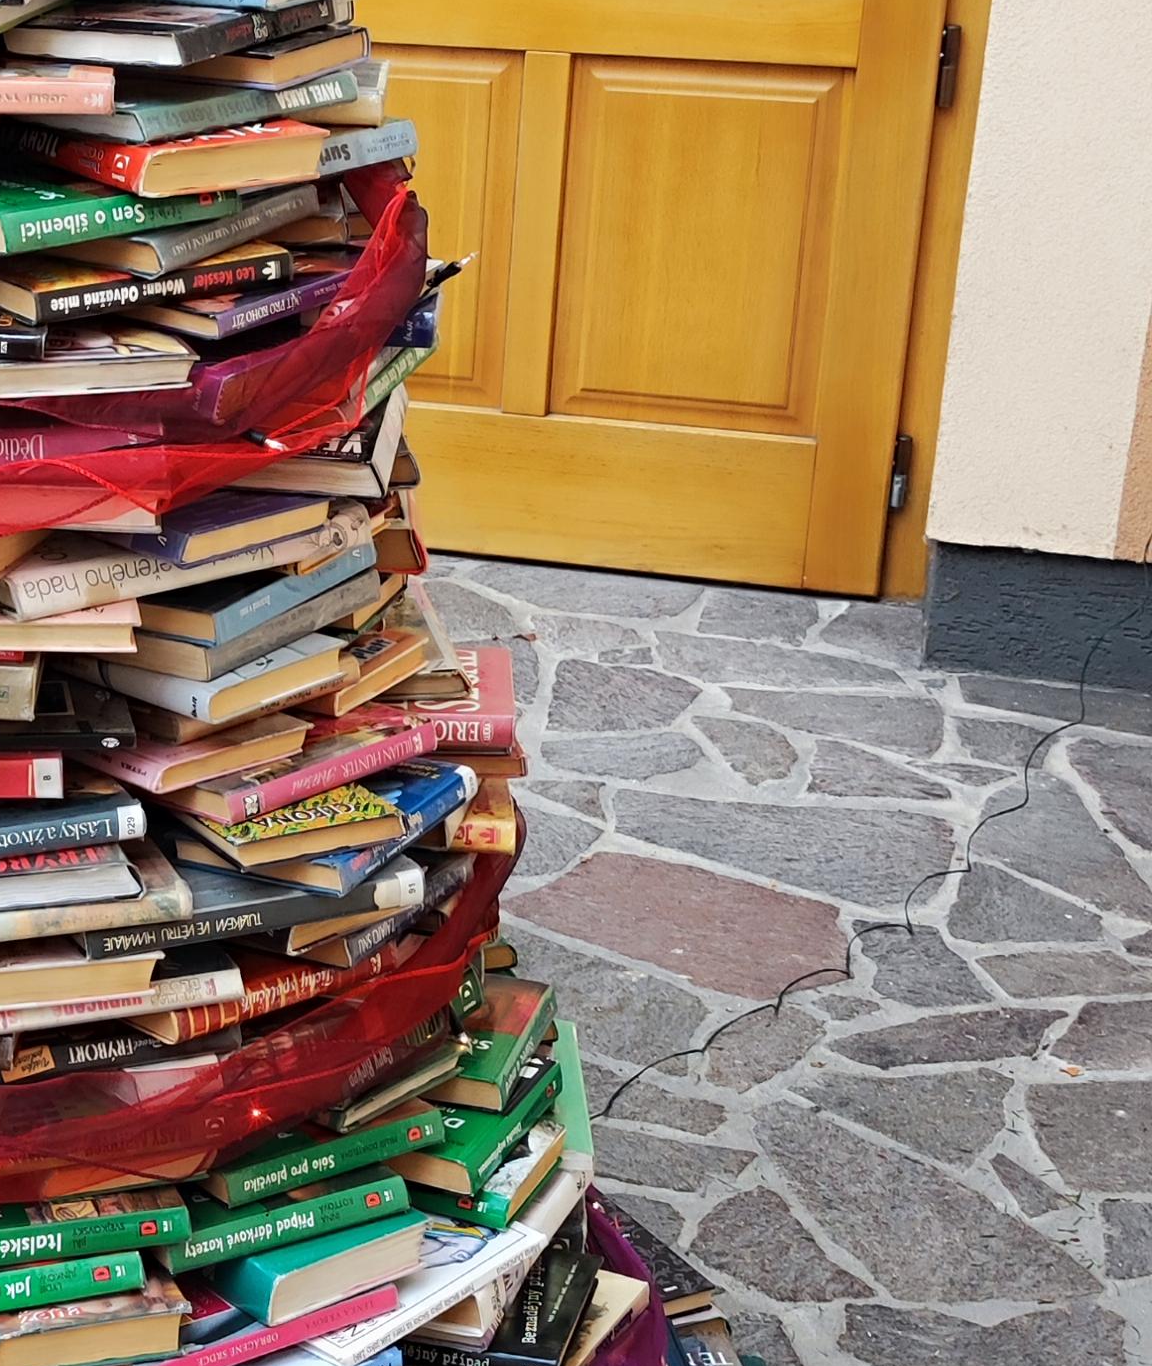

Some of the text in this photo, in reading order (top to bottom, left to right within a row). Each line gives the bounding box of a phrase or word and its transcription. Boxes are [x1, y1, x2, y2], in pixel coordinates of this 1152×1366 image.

[312, 80, 344, 96] PAVEL
[18, 201, 145, 242] Sen o šibenici
[51, 263, 255, 312] Leo Kessler Wotan: Odvážná mise
[22, 571, 80, 597] hada
[59, 817, 113, 842] Lásky
[126, 815, 135, 835] 929
[67, 1038, 134, 1064] FRÝBORT
[243, 1154, 335, 1193] Sólo pro plavčíka
[184, 1210, 315, 1259] Případ dárkové kazety
[5, 1276, 31, 1296] Jak
[231, 1331, 278, 1354] OBRÁCENÉ
